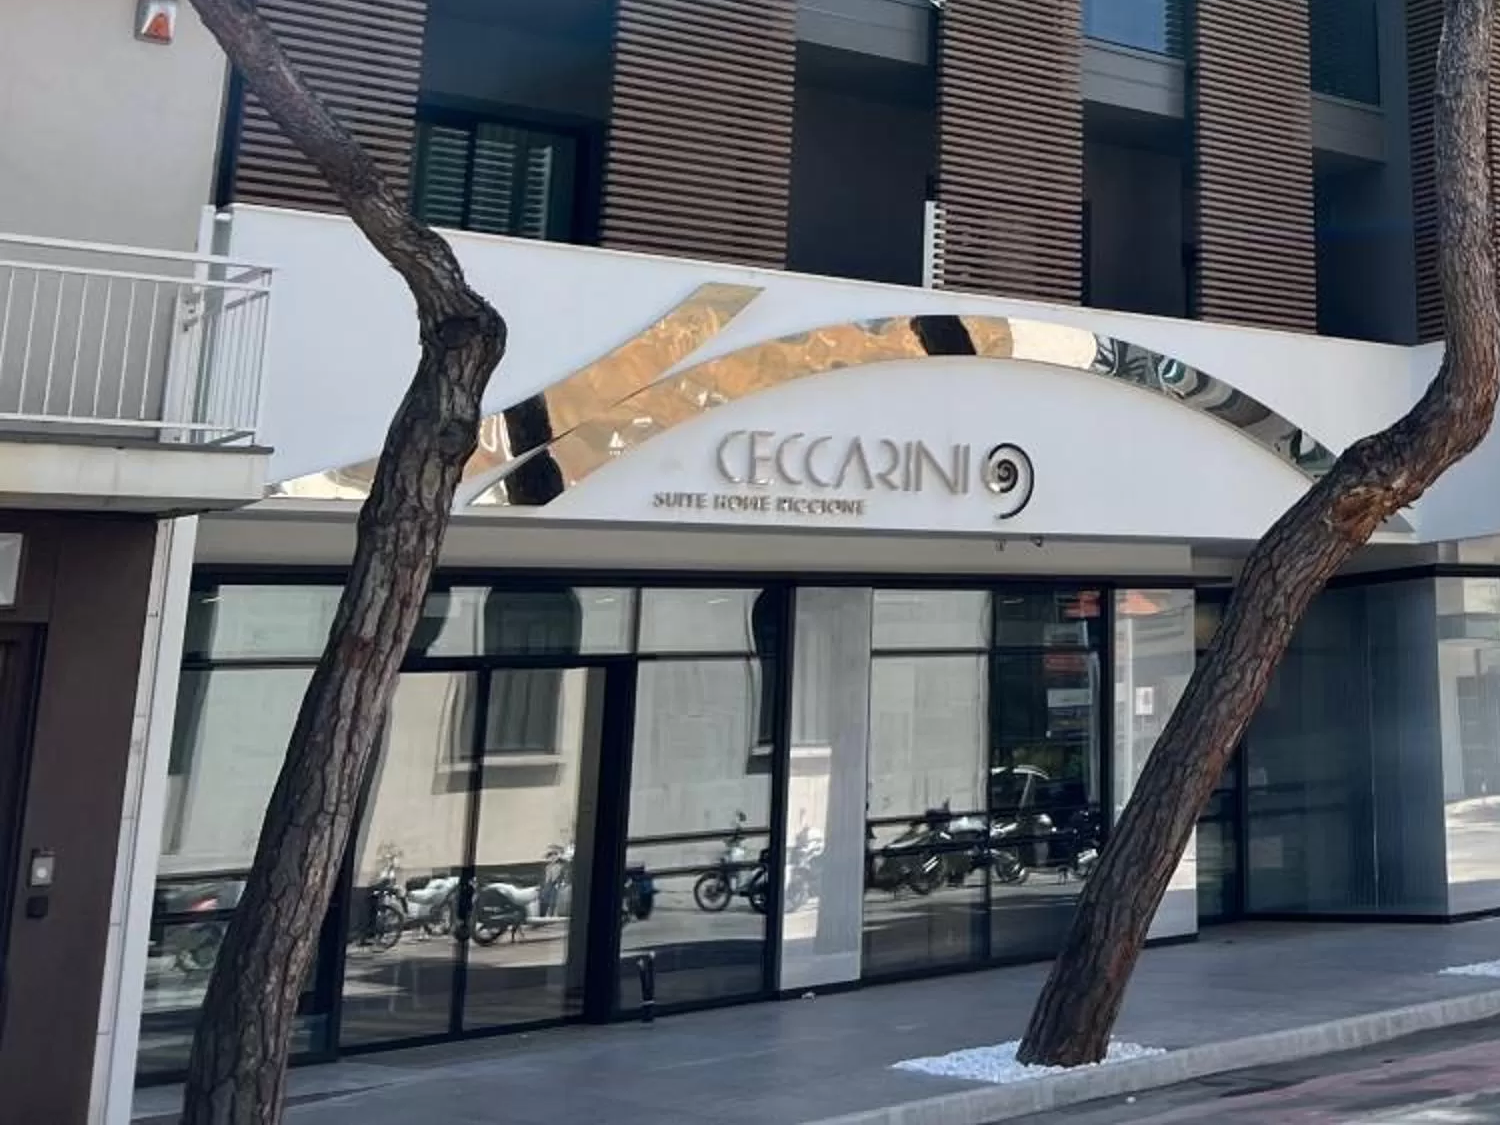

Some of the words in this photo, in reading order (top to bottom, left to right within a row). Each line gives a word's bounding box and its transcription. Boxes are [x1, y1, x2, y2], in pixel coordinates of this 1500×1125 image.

[714, 428, 971, 495] CECCARINI
[652, 492, 708, 509] SUITE
[775, 495, 866, 516] RICCIONE
